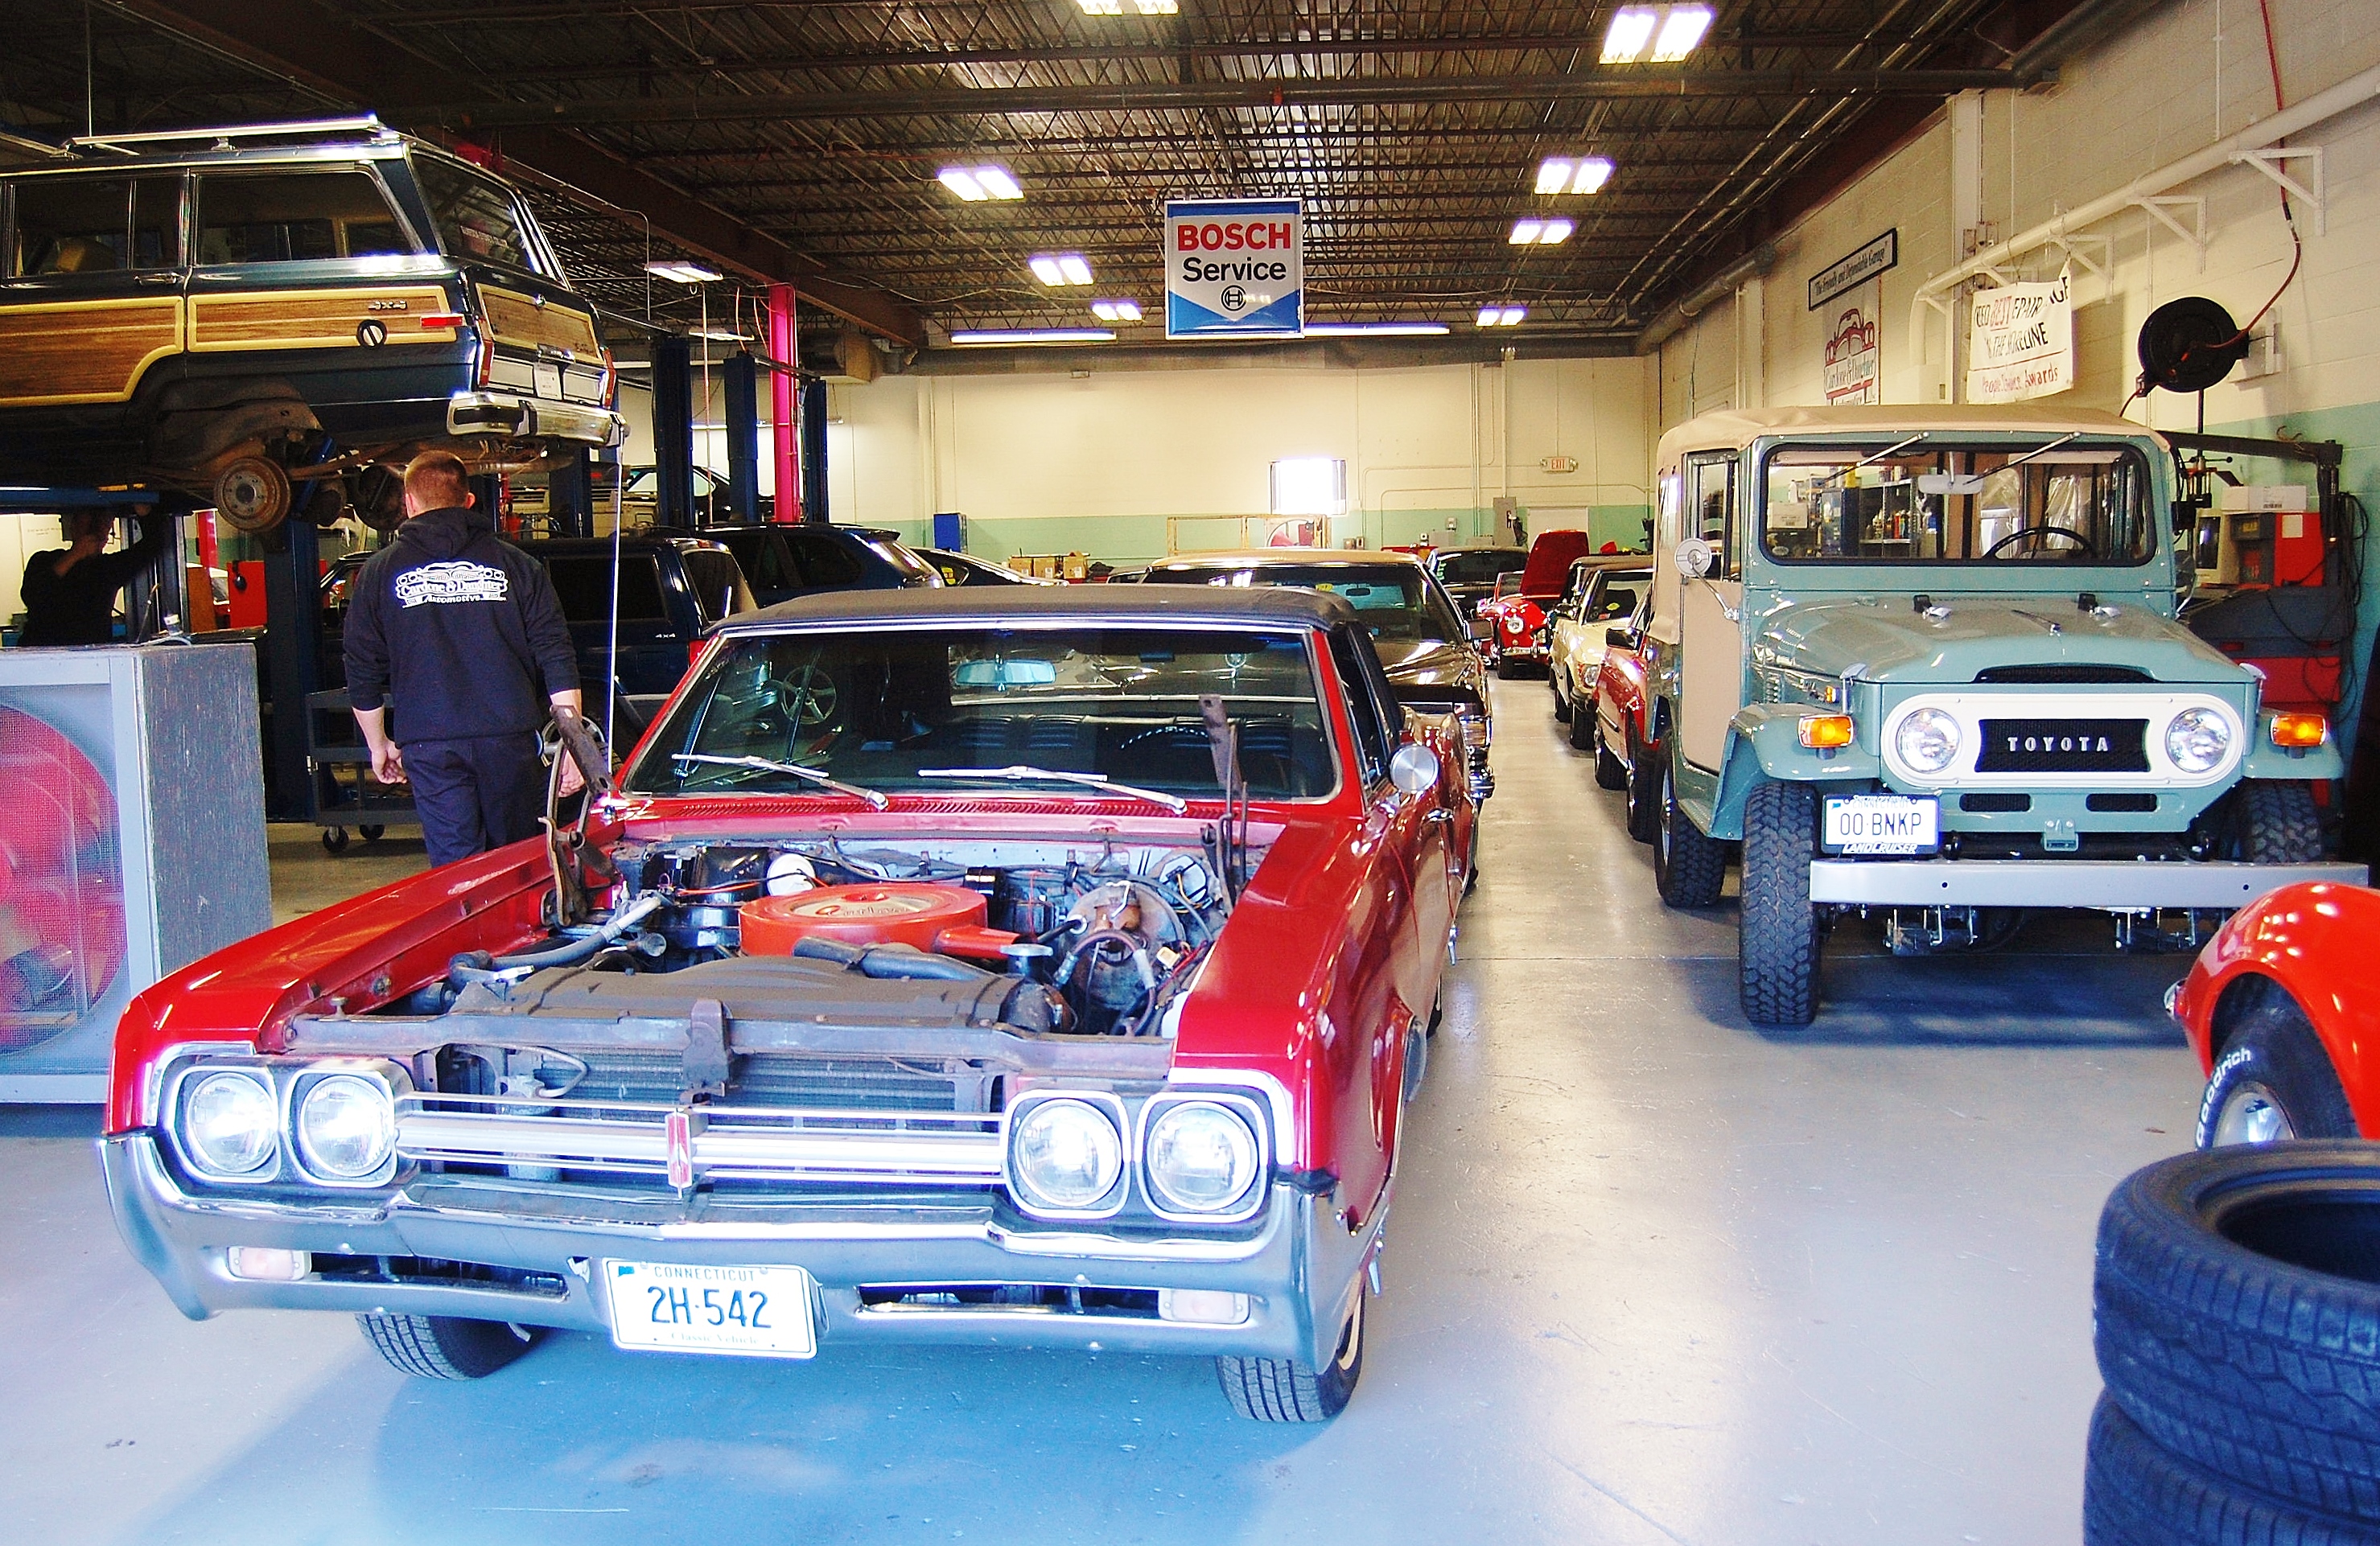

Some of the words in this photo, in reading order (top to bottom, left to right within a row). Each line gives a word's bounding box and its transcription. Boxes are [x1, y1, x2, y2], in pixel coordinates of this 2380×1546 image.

[1177, 223, 1291, 251] BOSCH
[1183, 257, 1286, 282] Service
[2011, 296, 2044, 320] EPAIR
[2024, 361, 2060, 389] Awards
[401, 580, 445, 597] Cardone
[446, 580, 457, 594] &
[2007, 736, 2109, 752] TOYOTA
[654, 1265, 756, 1282] CONNECTICUT
[671, 1331, 712, 1344] Classic
